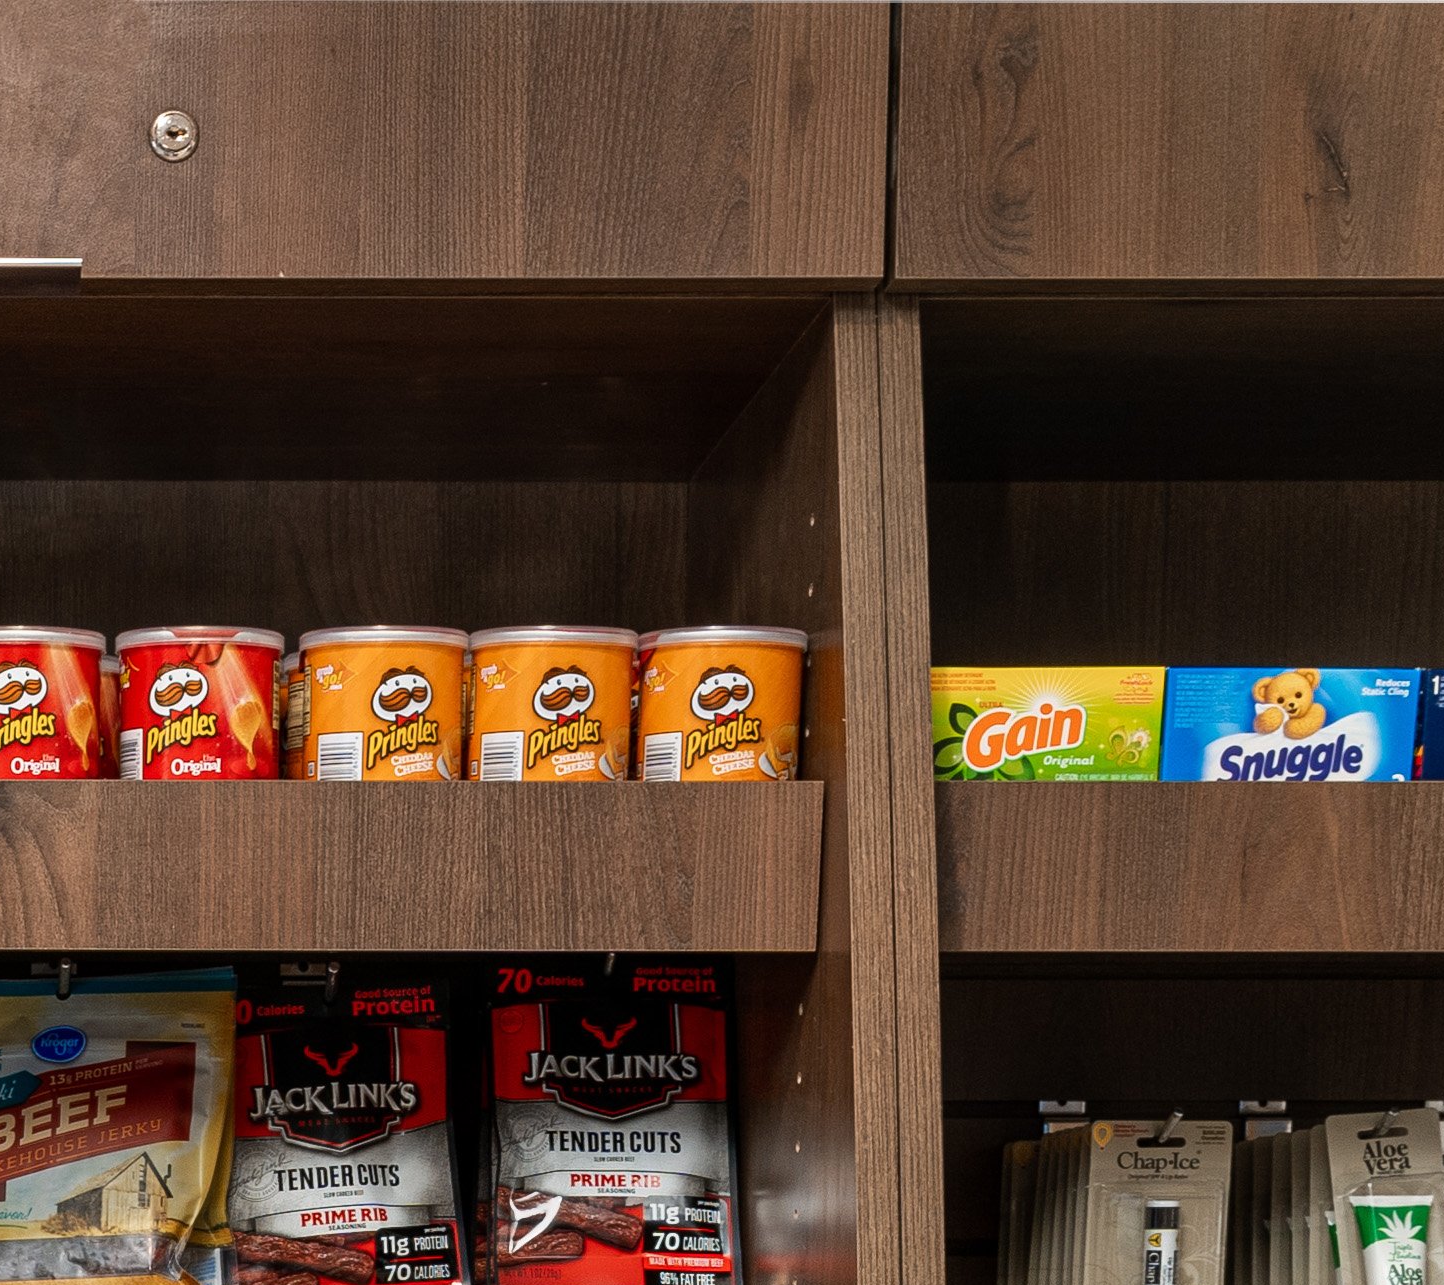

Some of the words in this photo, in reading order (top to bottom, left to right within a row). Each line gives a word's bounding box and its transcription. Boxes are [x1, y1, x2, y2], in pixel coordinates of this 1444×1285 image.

[963, 704, 1087, 769] Gain
[1042, 755, 1095, 767] Original
[1219, 737, 1364, 783] Snuggle
[632, 976, 716, 994] Protein
[40, 1033, 79, 1057] Kroger
[49, 1073, 72, 1088] 13g
[75, 1062, 133, 1081] PROTEIN
[251, 1085, 329, 1121] JACK
[330, 1081, 417, 1113] LINK'S
[97, 1118, 162, 1144] JERKY
[546, 1130, 625, 1153] TENDER
[629, 1131, 682, 1153] CUTS
[1363, 1141, 1408, 1160] Aloe
[1364, 1154, 1412, 1174] Vera
[301, 1210, 357, 1228] PRIME
[361, 1207, 388, 1223] RIB
[653, 1232, 679, 1251] 70
[682, 1235, 723, 1252] CALORIES
